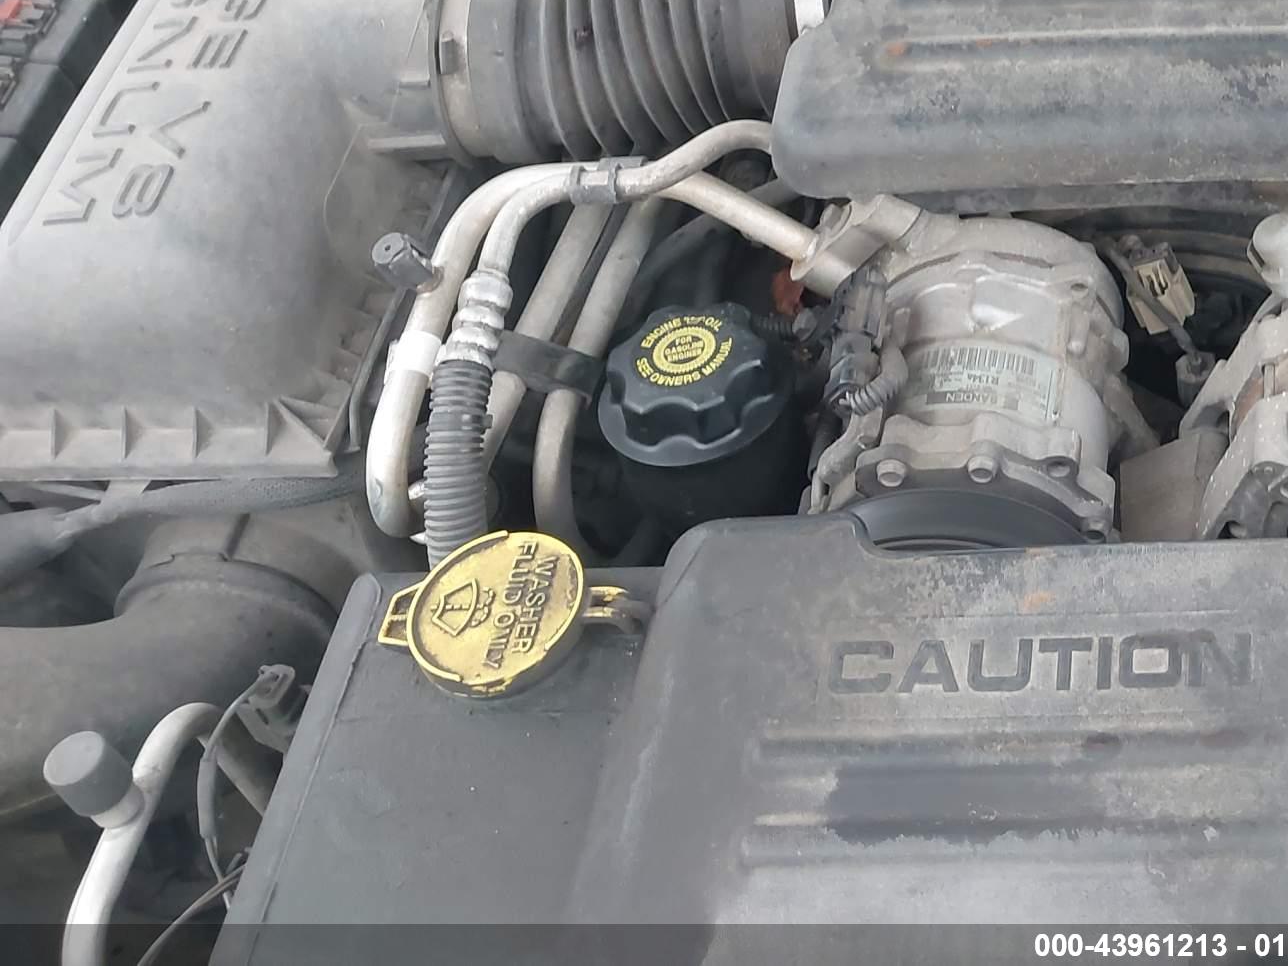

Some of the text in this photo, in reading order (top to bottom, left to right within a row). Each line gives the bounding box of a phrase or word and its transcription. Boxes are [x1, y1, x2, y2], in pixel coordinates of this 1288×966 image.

[112, 100, 212, 218] V8
[484, 541, 538, 668] FLUID ONLY
[512, 556, 558, 653] WASHER
[828, 633, 1252, 694] CAUTION
